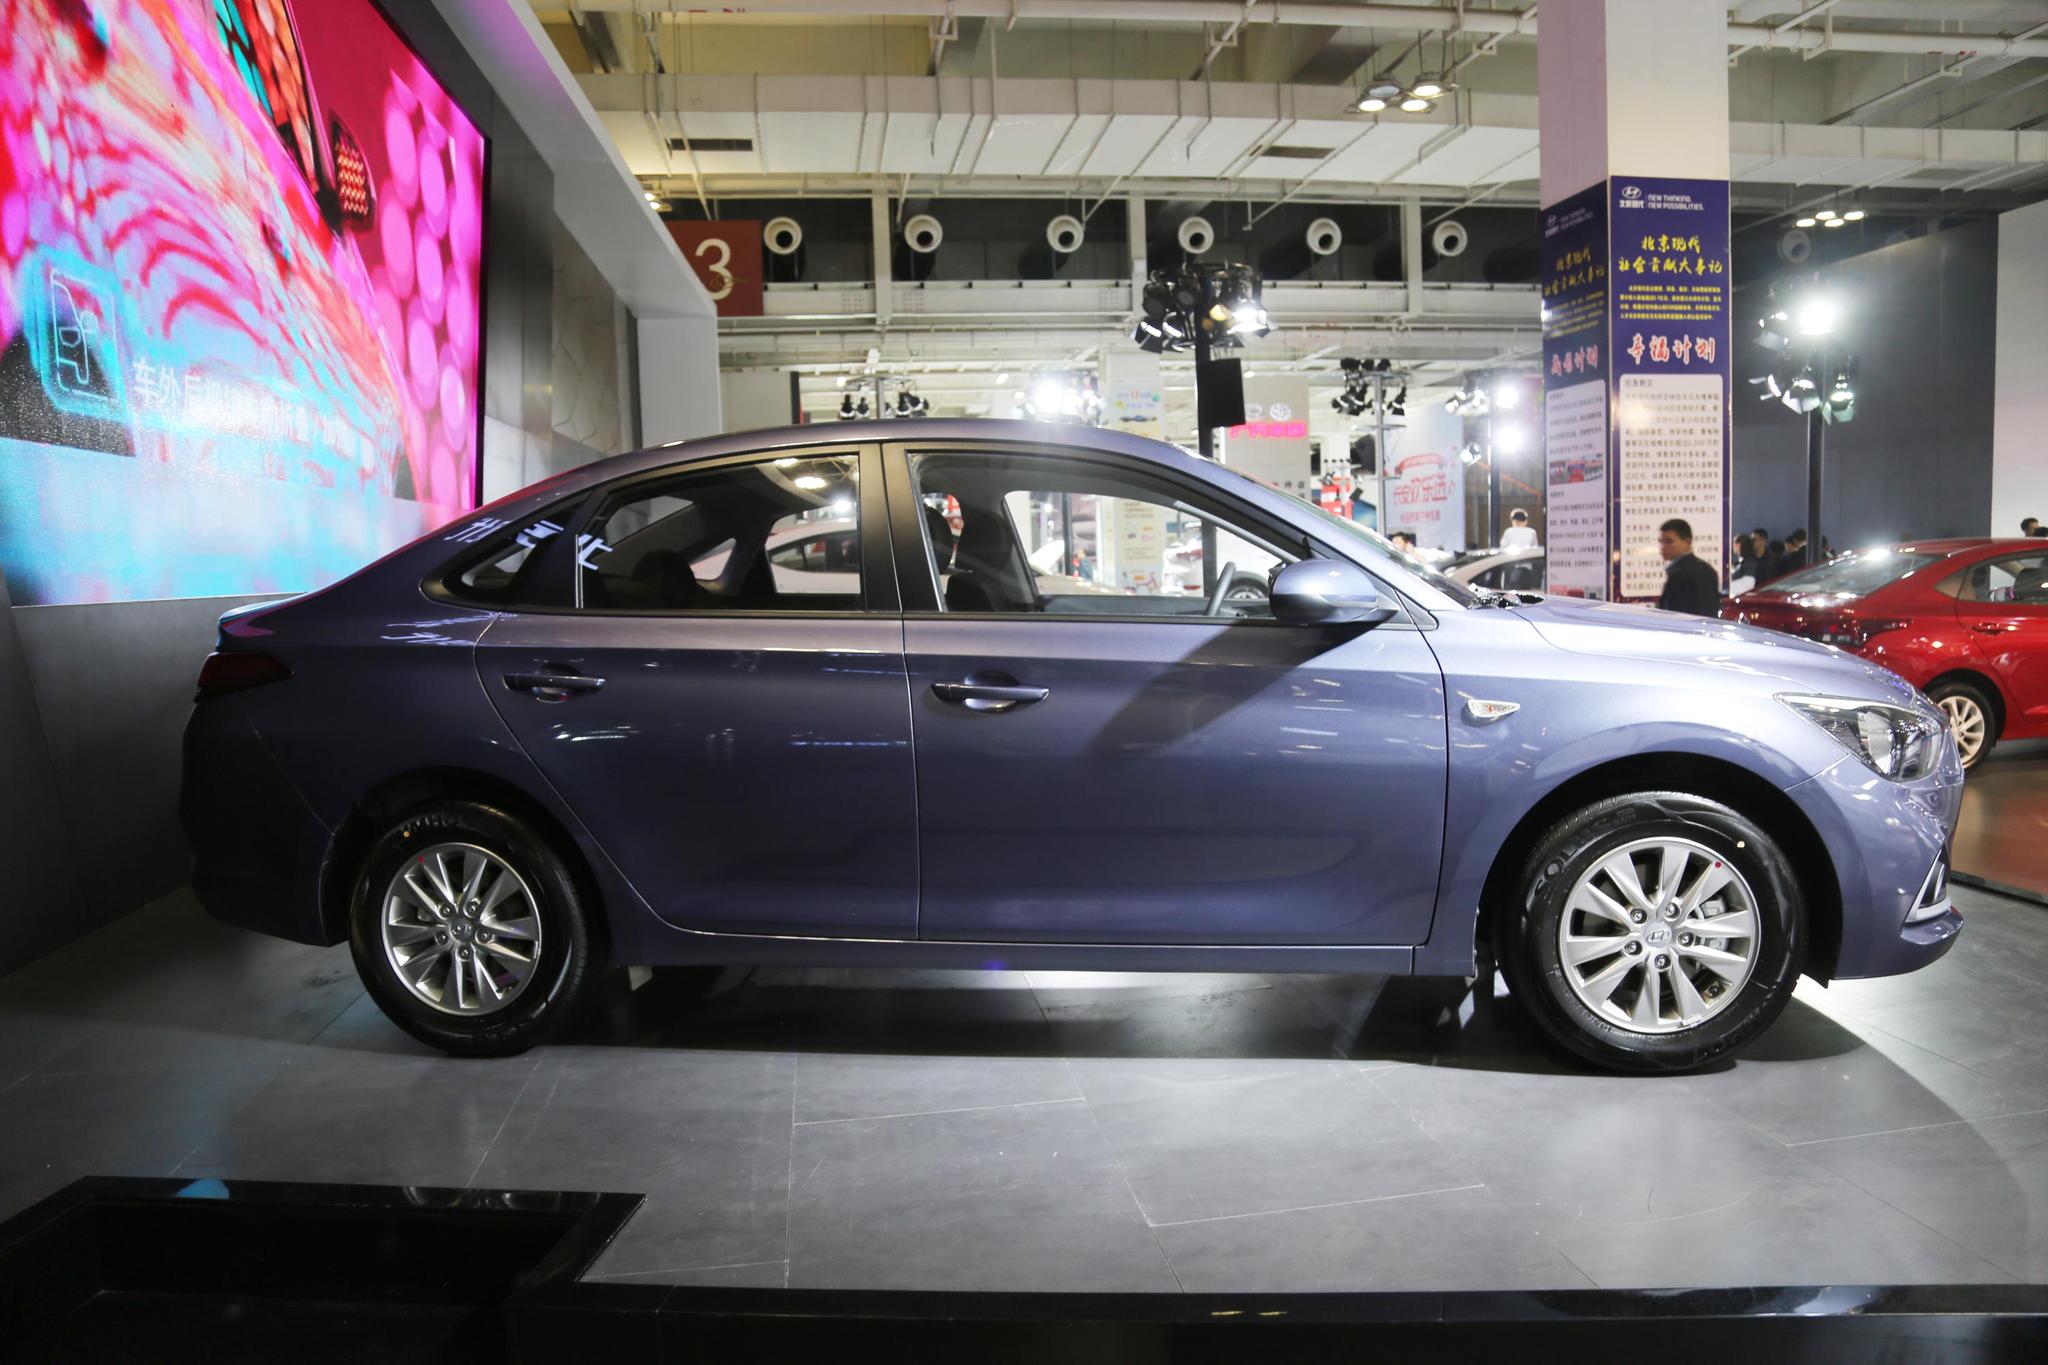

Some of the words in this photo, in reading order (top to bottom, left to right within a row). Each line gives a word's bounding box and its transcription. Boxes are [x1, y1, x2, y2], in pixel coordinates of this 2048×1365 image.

[1641, 234, 1701, 254] 北京现代
[694, 238, 734, 301] 3
[1618, 256, 1723, 276] 社会贡献大事记
[1627, 332, 1716, 365] 幸福计划
